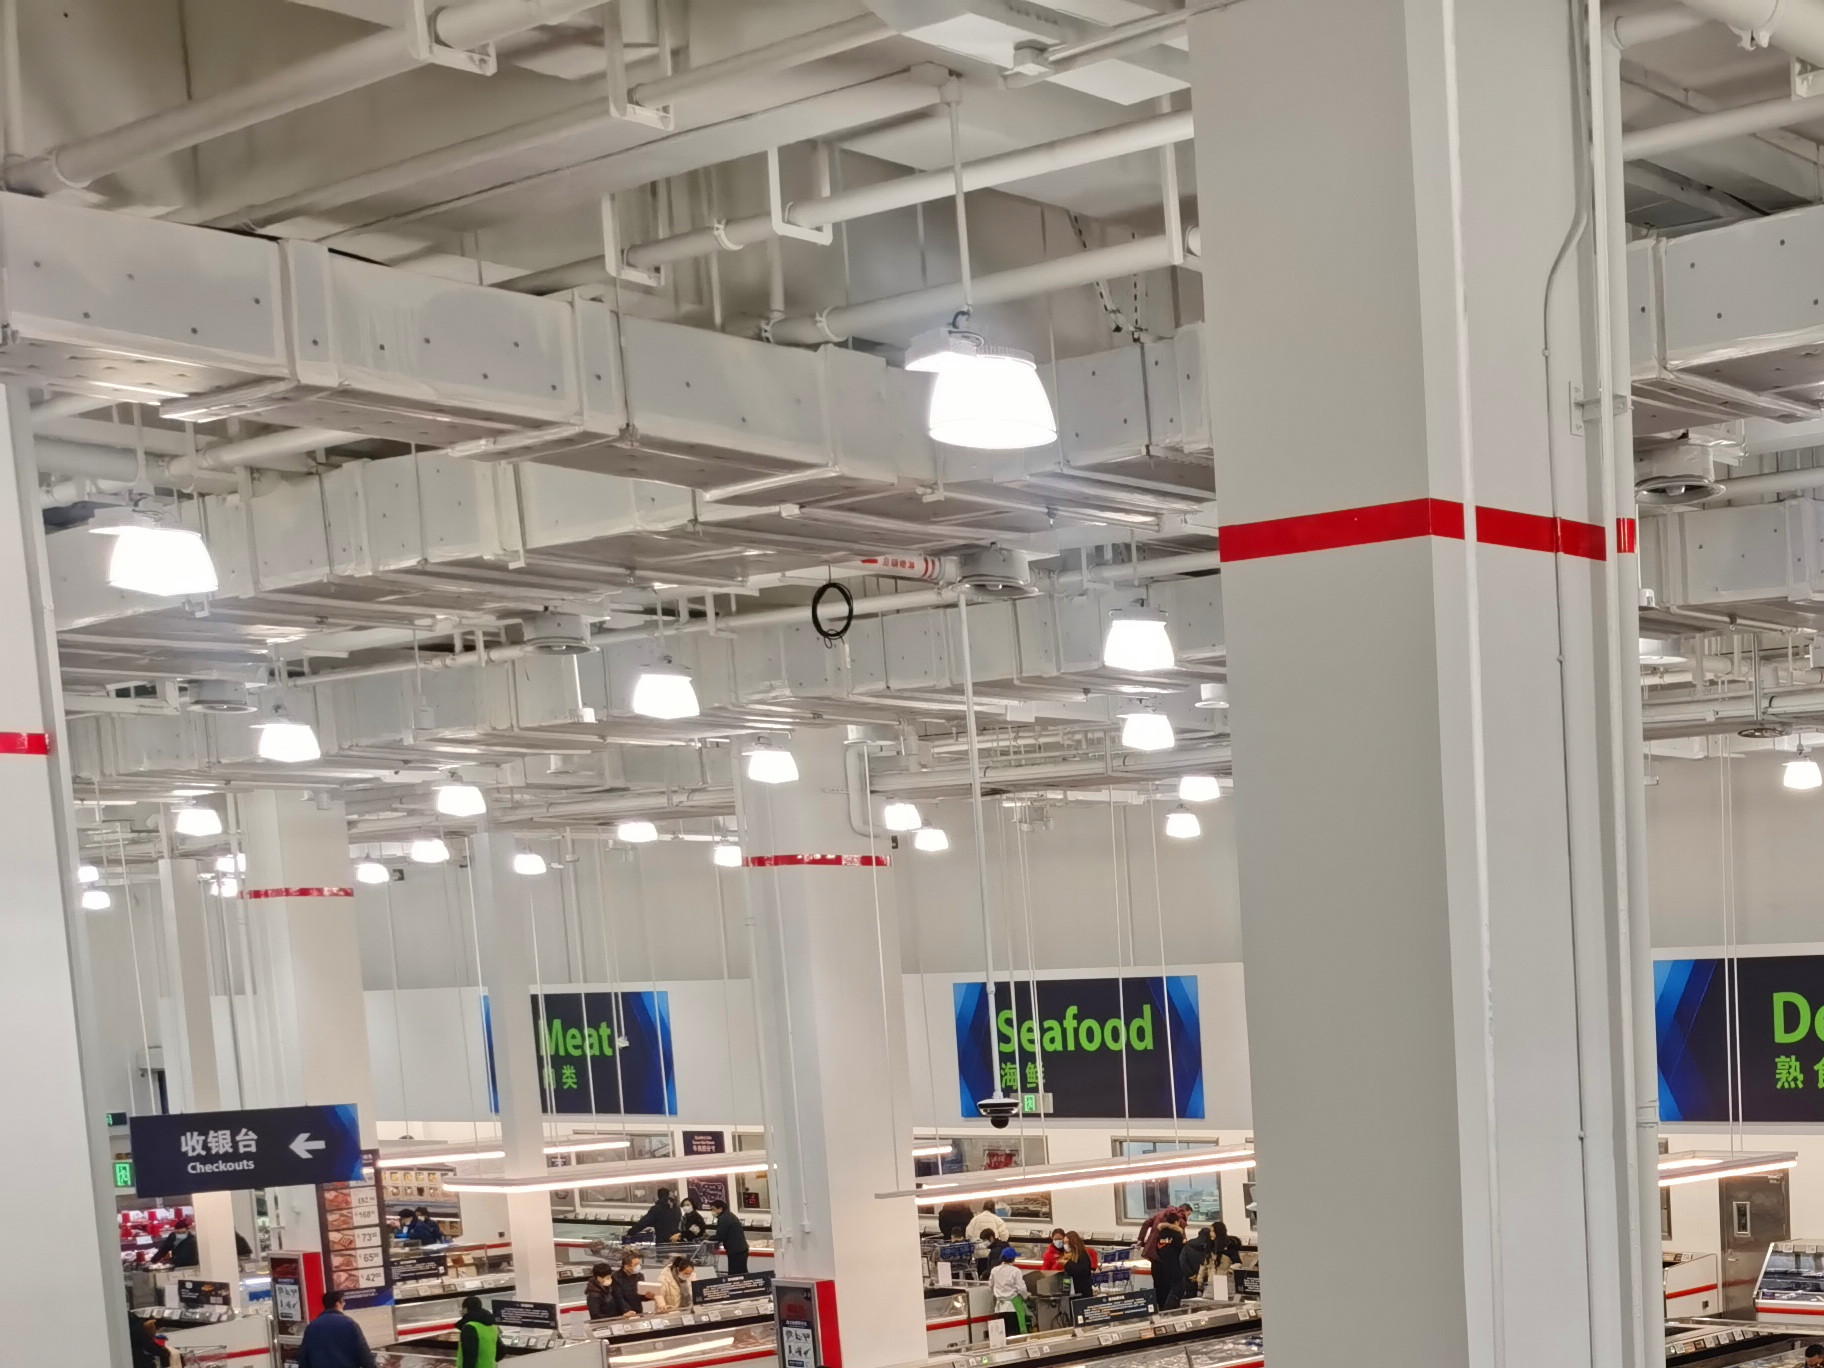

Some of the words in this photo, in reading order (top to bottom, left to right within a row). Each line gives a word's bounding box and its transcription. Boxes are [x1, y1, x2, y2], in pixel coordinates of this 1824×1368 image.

[538, 1019, 614, 1057] Meat
[997, 1004, 1155, 1053] Seafood
[180, 1128, 258, 1157] 收银台
[187, 1159, 255, 1174] Checkouts
